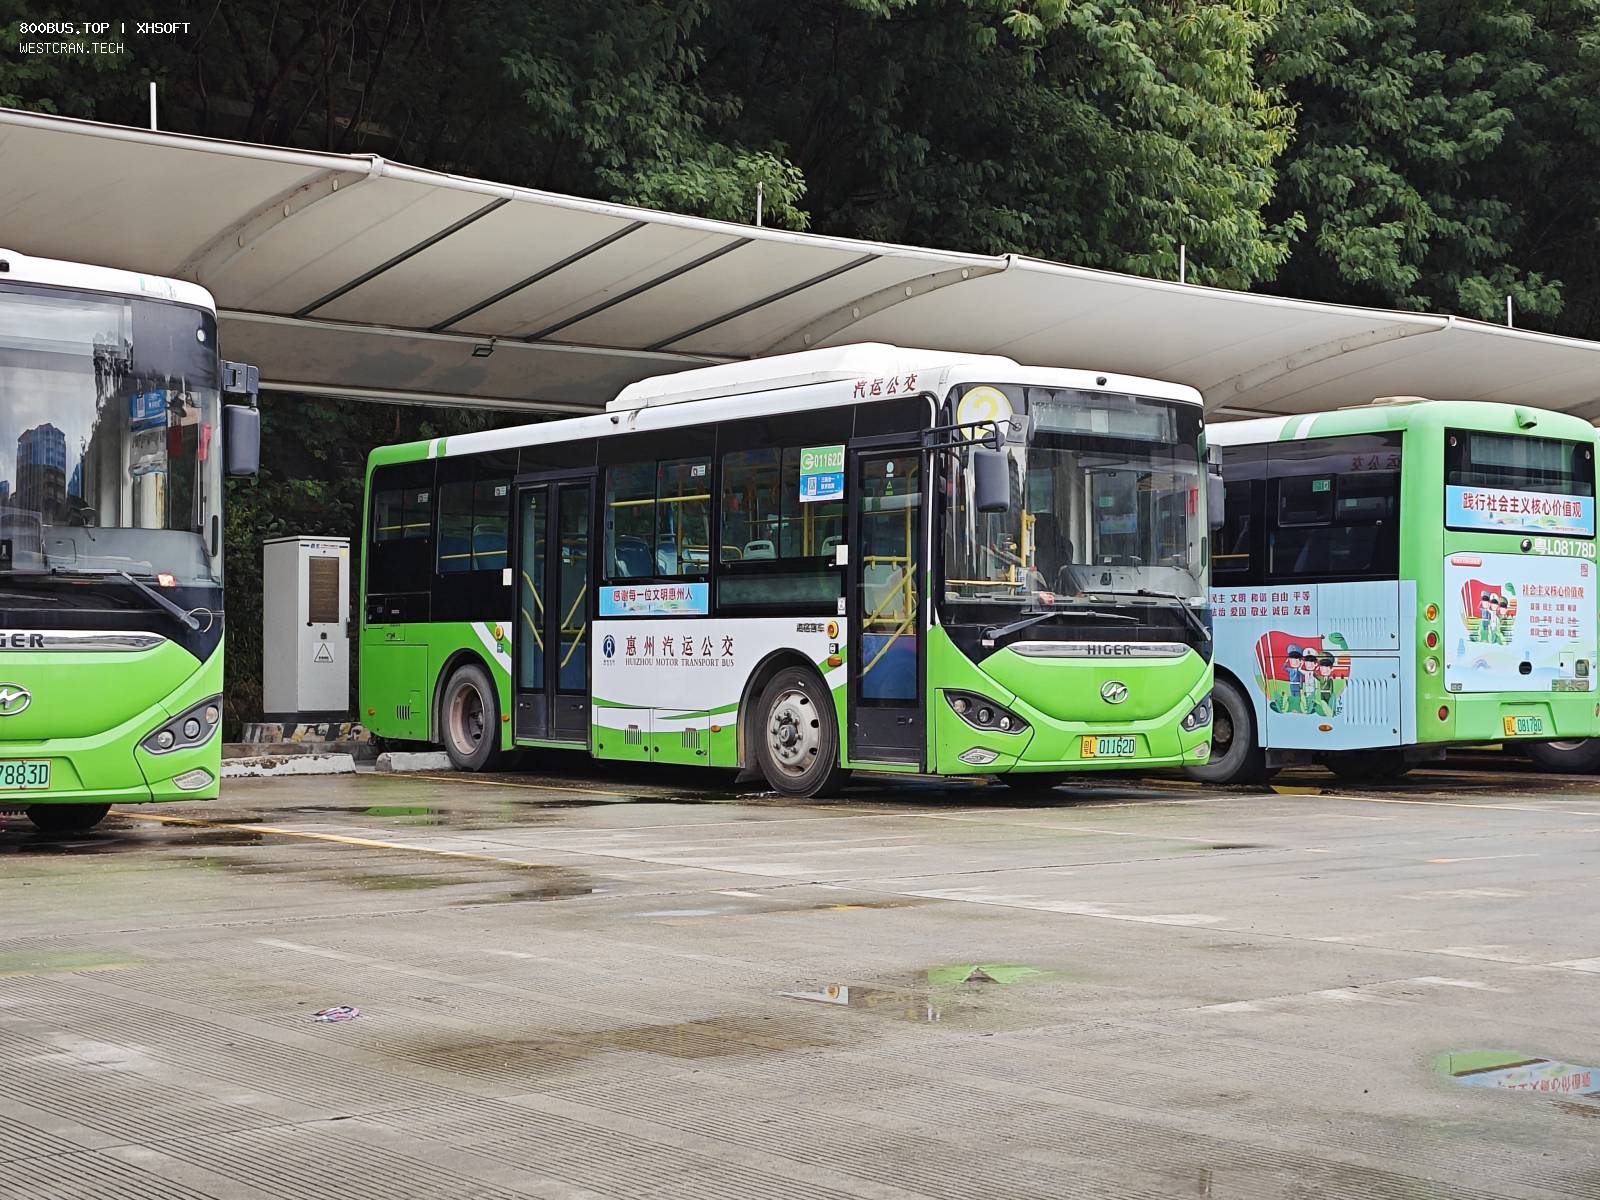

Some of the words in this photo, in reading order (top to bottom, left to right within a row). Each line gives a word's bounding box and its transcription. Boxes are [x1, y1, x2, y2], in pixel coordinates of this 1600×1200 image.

[853, 373, 918, 398] 汽运公交
[1463, 492, 1582, 518] 践行社会主义核心价值观
[613, 587, 693, 602] 感谢每一位文明惠州人
[1230, 593, 1247, 603] 文明
[1293, 591, 1310, 601] 平等
[1293, 605, 1311, 616] 友善
[626, 634, 734, 657] 惠州汽运公交
[1087, 644, 1131, 656] HIGER
[625, 658, 653, 667] HUIZHOU
[656, 658, 679, 667] MOTOR
[681, 658, 720, 667] TRANSPORT
[721, 658, 735, 667] BUS
[1099, 739, 1135, 754] 01162D
